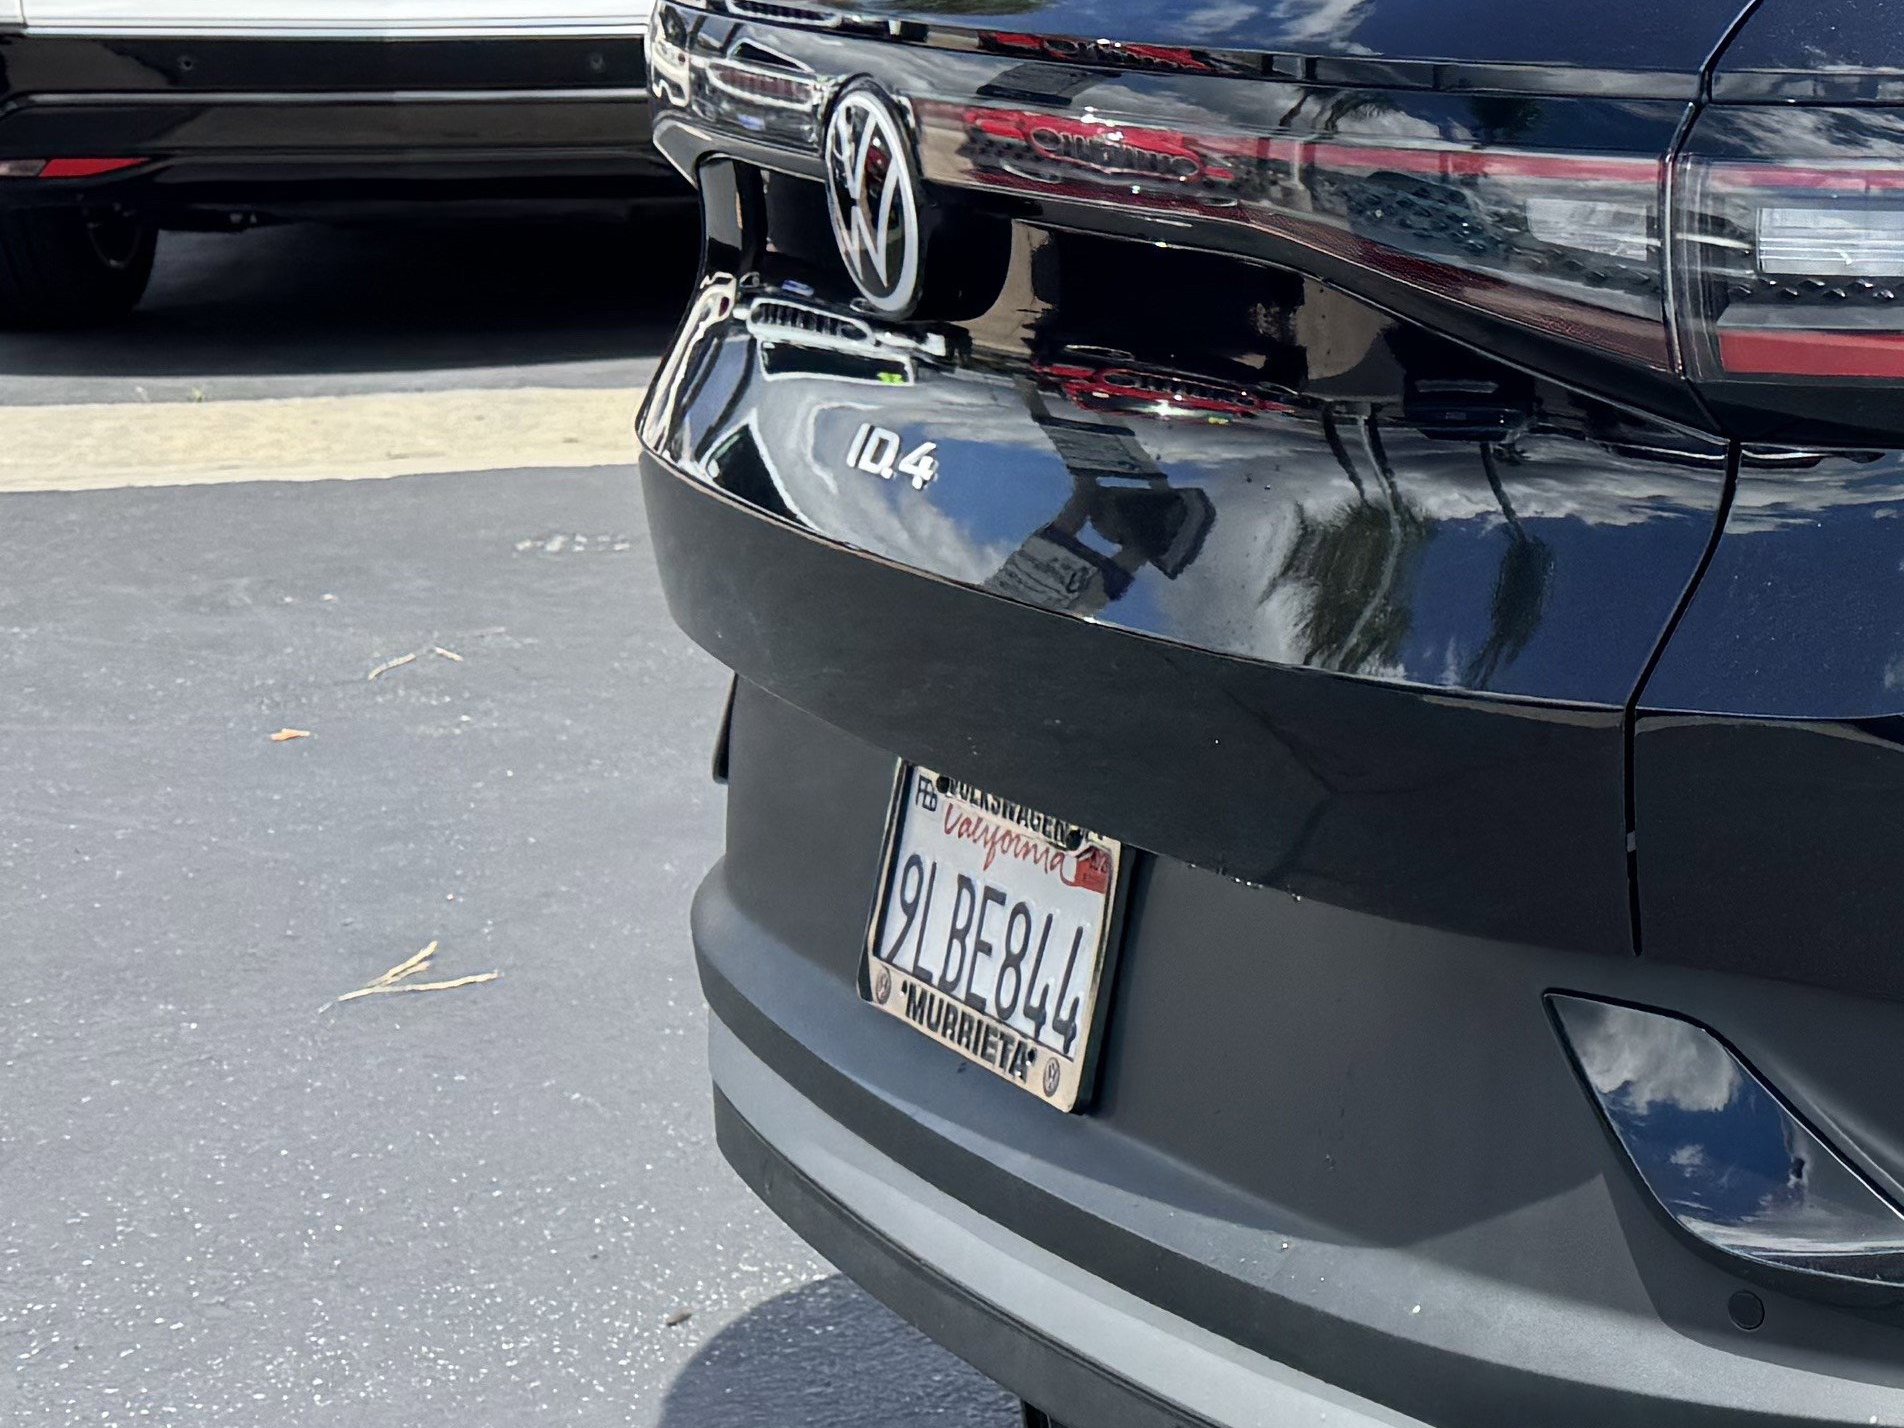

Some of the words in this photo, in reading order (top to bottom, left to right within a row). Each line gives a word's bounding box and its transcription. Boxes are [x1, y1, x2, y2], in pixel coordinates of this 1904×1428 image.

[845, 422, 939, 490] ID.4
[944, 803, 1077, 887] California
[880, 853, 1084, 1054] 9LBE844
[904, 981, 1029, 1084] MURRIETA
